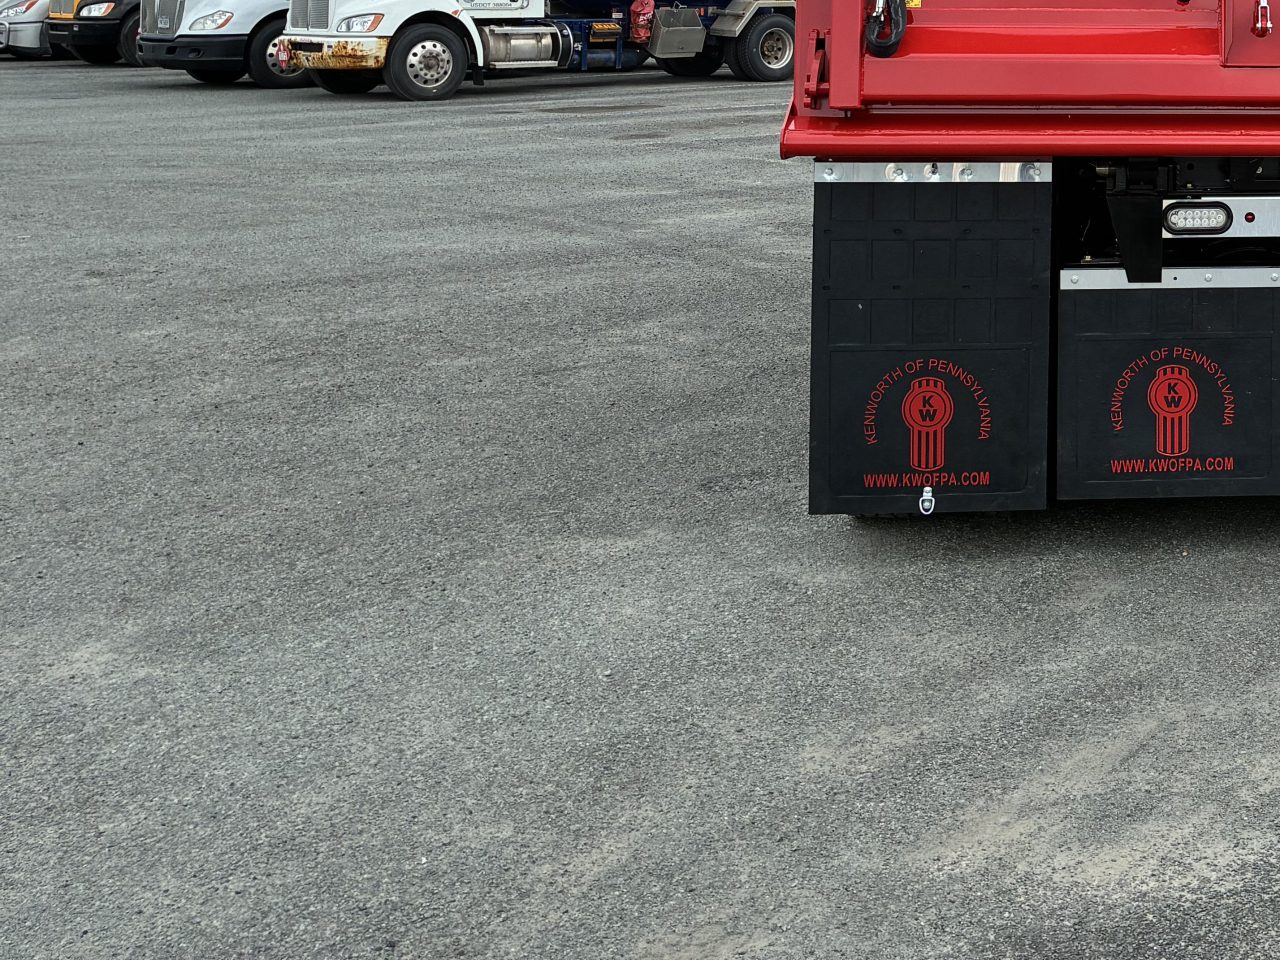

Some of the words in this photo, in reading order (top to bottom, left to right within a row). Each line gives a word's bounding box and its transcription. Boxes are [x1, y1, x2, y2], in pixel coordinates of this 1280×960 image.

[864, 367, 905, 445] KENWORTH
[904, 358, 924, 374] OF
[928, 358, 992, 440] PENNSYLVANIA
[1110, 355, 1149, 431] KENWORTH
[1150, 347, 1169, 361] OF
[1173, 346, 1235, 426] PENNSYLVANIA
[863, 471, 990, 488] WWW.KWOFPA.COM
[1110, 456, 1234, 473] WWW.KWOFPA.COM
